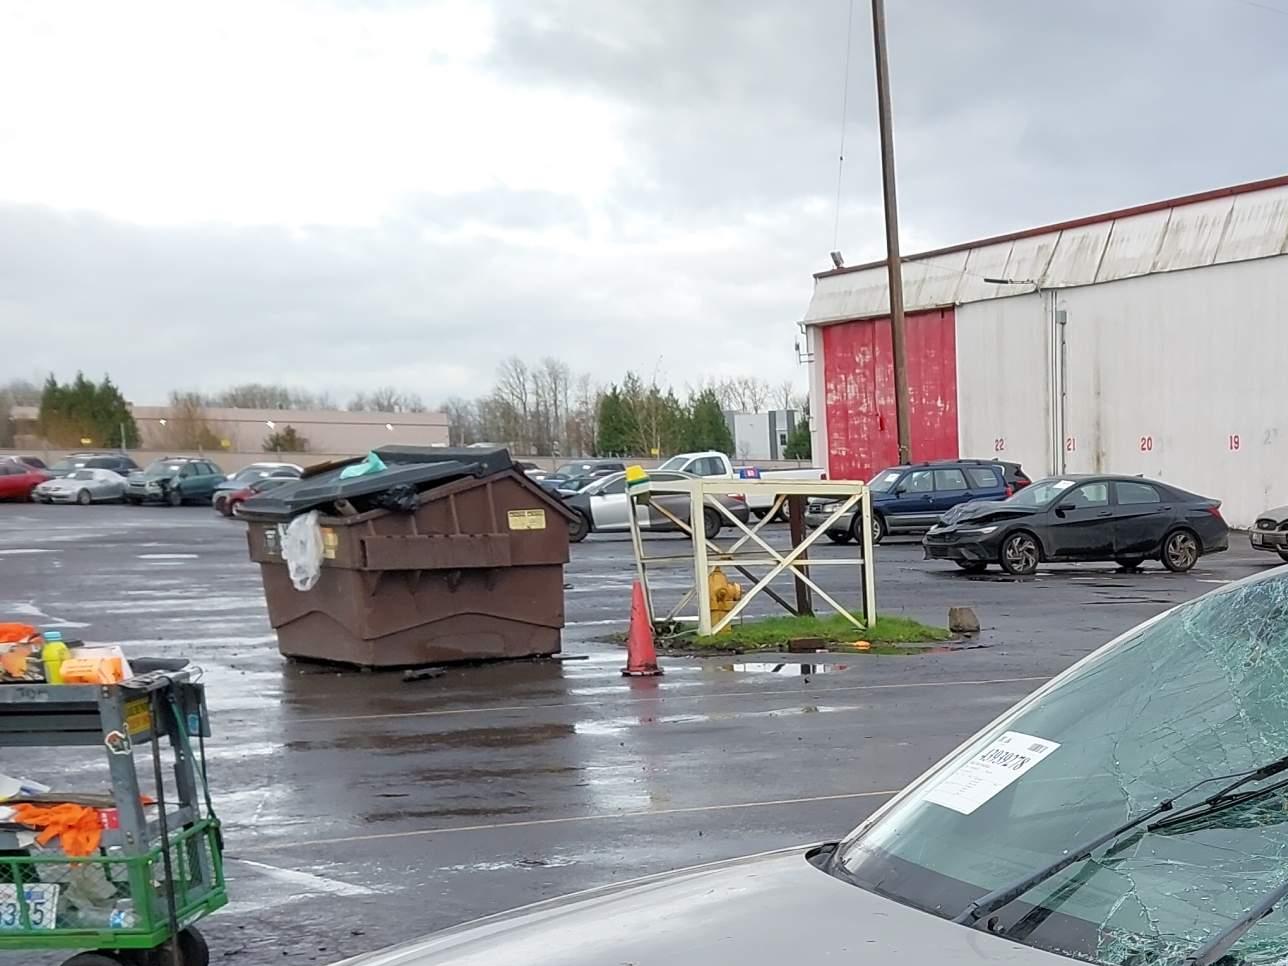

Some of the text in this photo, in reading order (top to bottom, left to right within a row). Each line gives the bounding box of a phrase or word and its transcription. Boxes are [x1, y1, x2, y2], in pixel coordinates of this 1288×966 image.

[994, 438, 1005, 452] 22
[1066, 438, 1077, 452] 21
[1140, 436, 1153, 451] 20
[1229, 435, 1240, 450] 19
[980, 748, 1031, 771] 43939278
